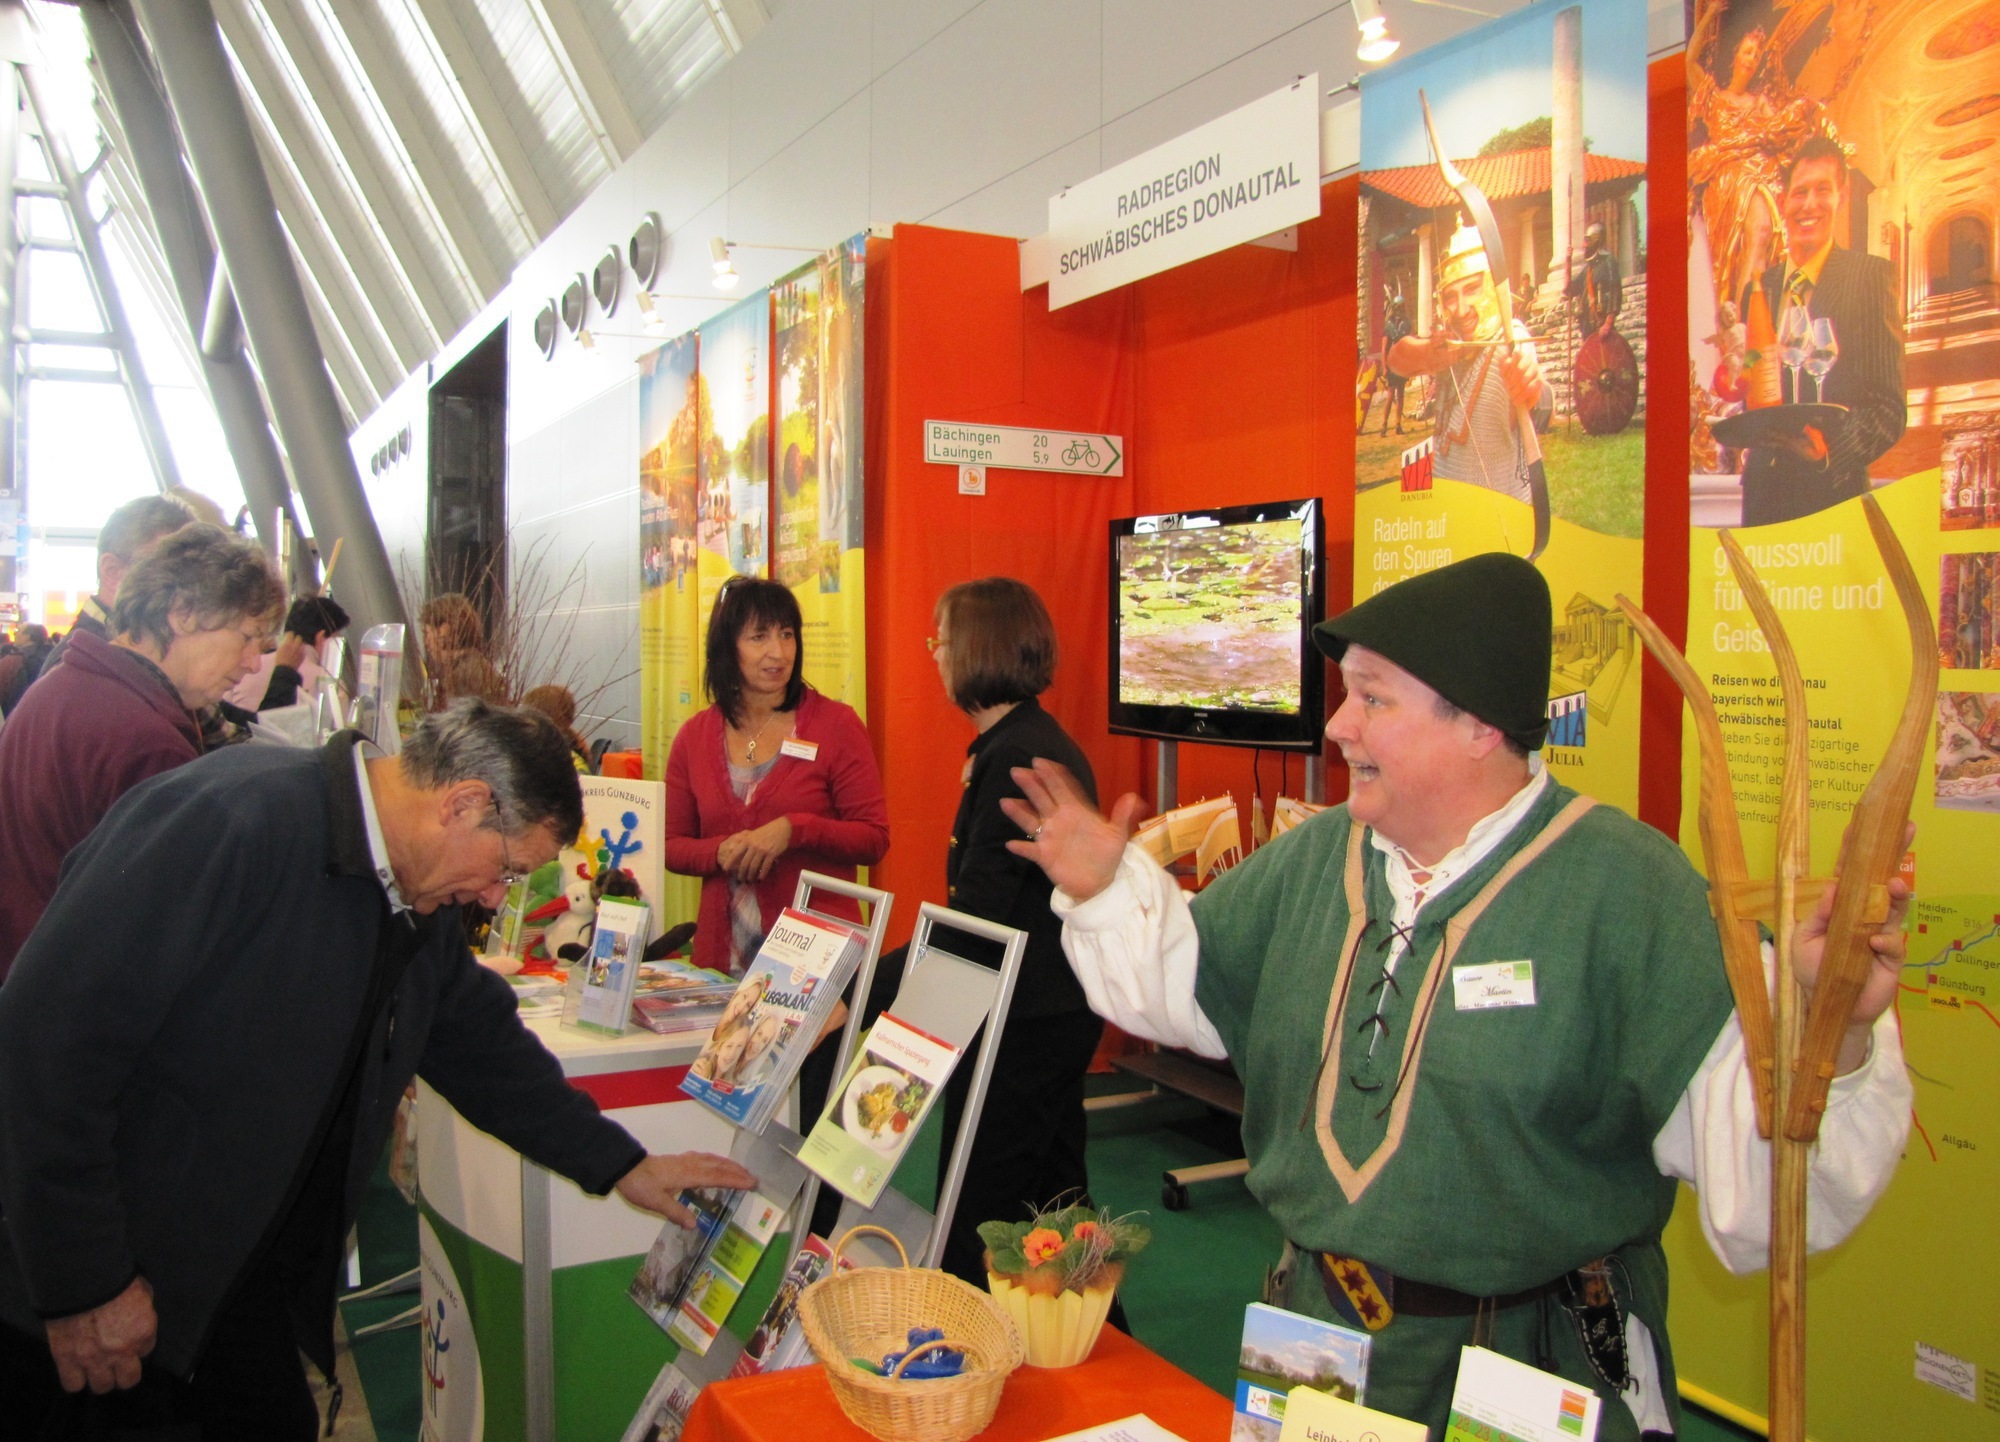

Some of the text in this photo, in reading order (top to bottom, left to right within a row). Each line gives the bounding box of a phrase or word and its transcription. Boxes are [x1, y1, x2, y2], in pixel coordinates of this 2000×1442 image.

[1117, 153, 1221, 218] RADREGION
[1060, 162, 1301, 275] SCHWÄBISCHES DONAUTAL
[933, 426, 1048, 447] Bächingen 20
[933, 444, 1049, 464] Lauingen 5,9
[1400, 492, 1433, 502] DANUBIA
[1373, 512, 1448, 542] Radeln auf
[1373, 545, 1453, 574] den Spuren
[1714, 534, 1843, 576] gnussvoll
[1832, 577, 1885, 610] und
[1713, 621, 1772, 653] Geis
[1712, 673, 1749, 686] Reisen
[1751, 677, 1767, 687] wo
[1769, 676, 1781, 688] di
[1711, 693, 1764, 707] bayerisch
[1716, 712, 1786, 727] chwäbisches
[1754, 733, 1771, 746] Sie
[584, 787, 605, 797] KREIS
[1827, 778, 1865, 792] Kultur
[1917, 911, 1943, 924] heim
[1918, 901, 1959, 915] Heiden-
[767, 922, 817, 952] journal
[1938, 976, 1986, 996] Günzburg
[1941, 1133, 1977, 1151] Allgäu
